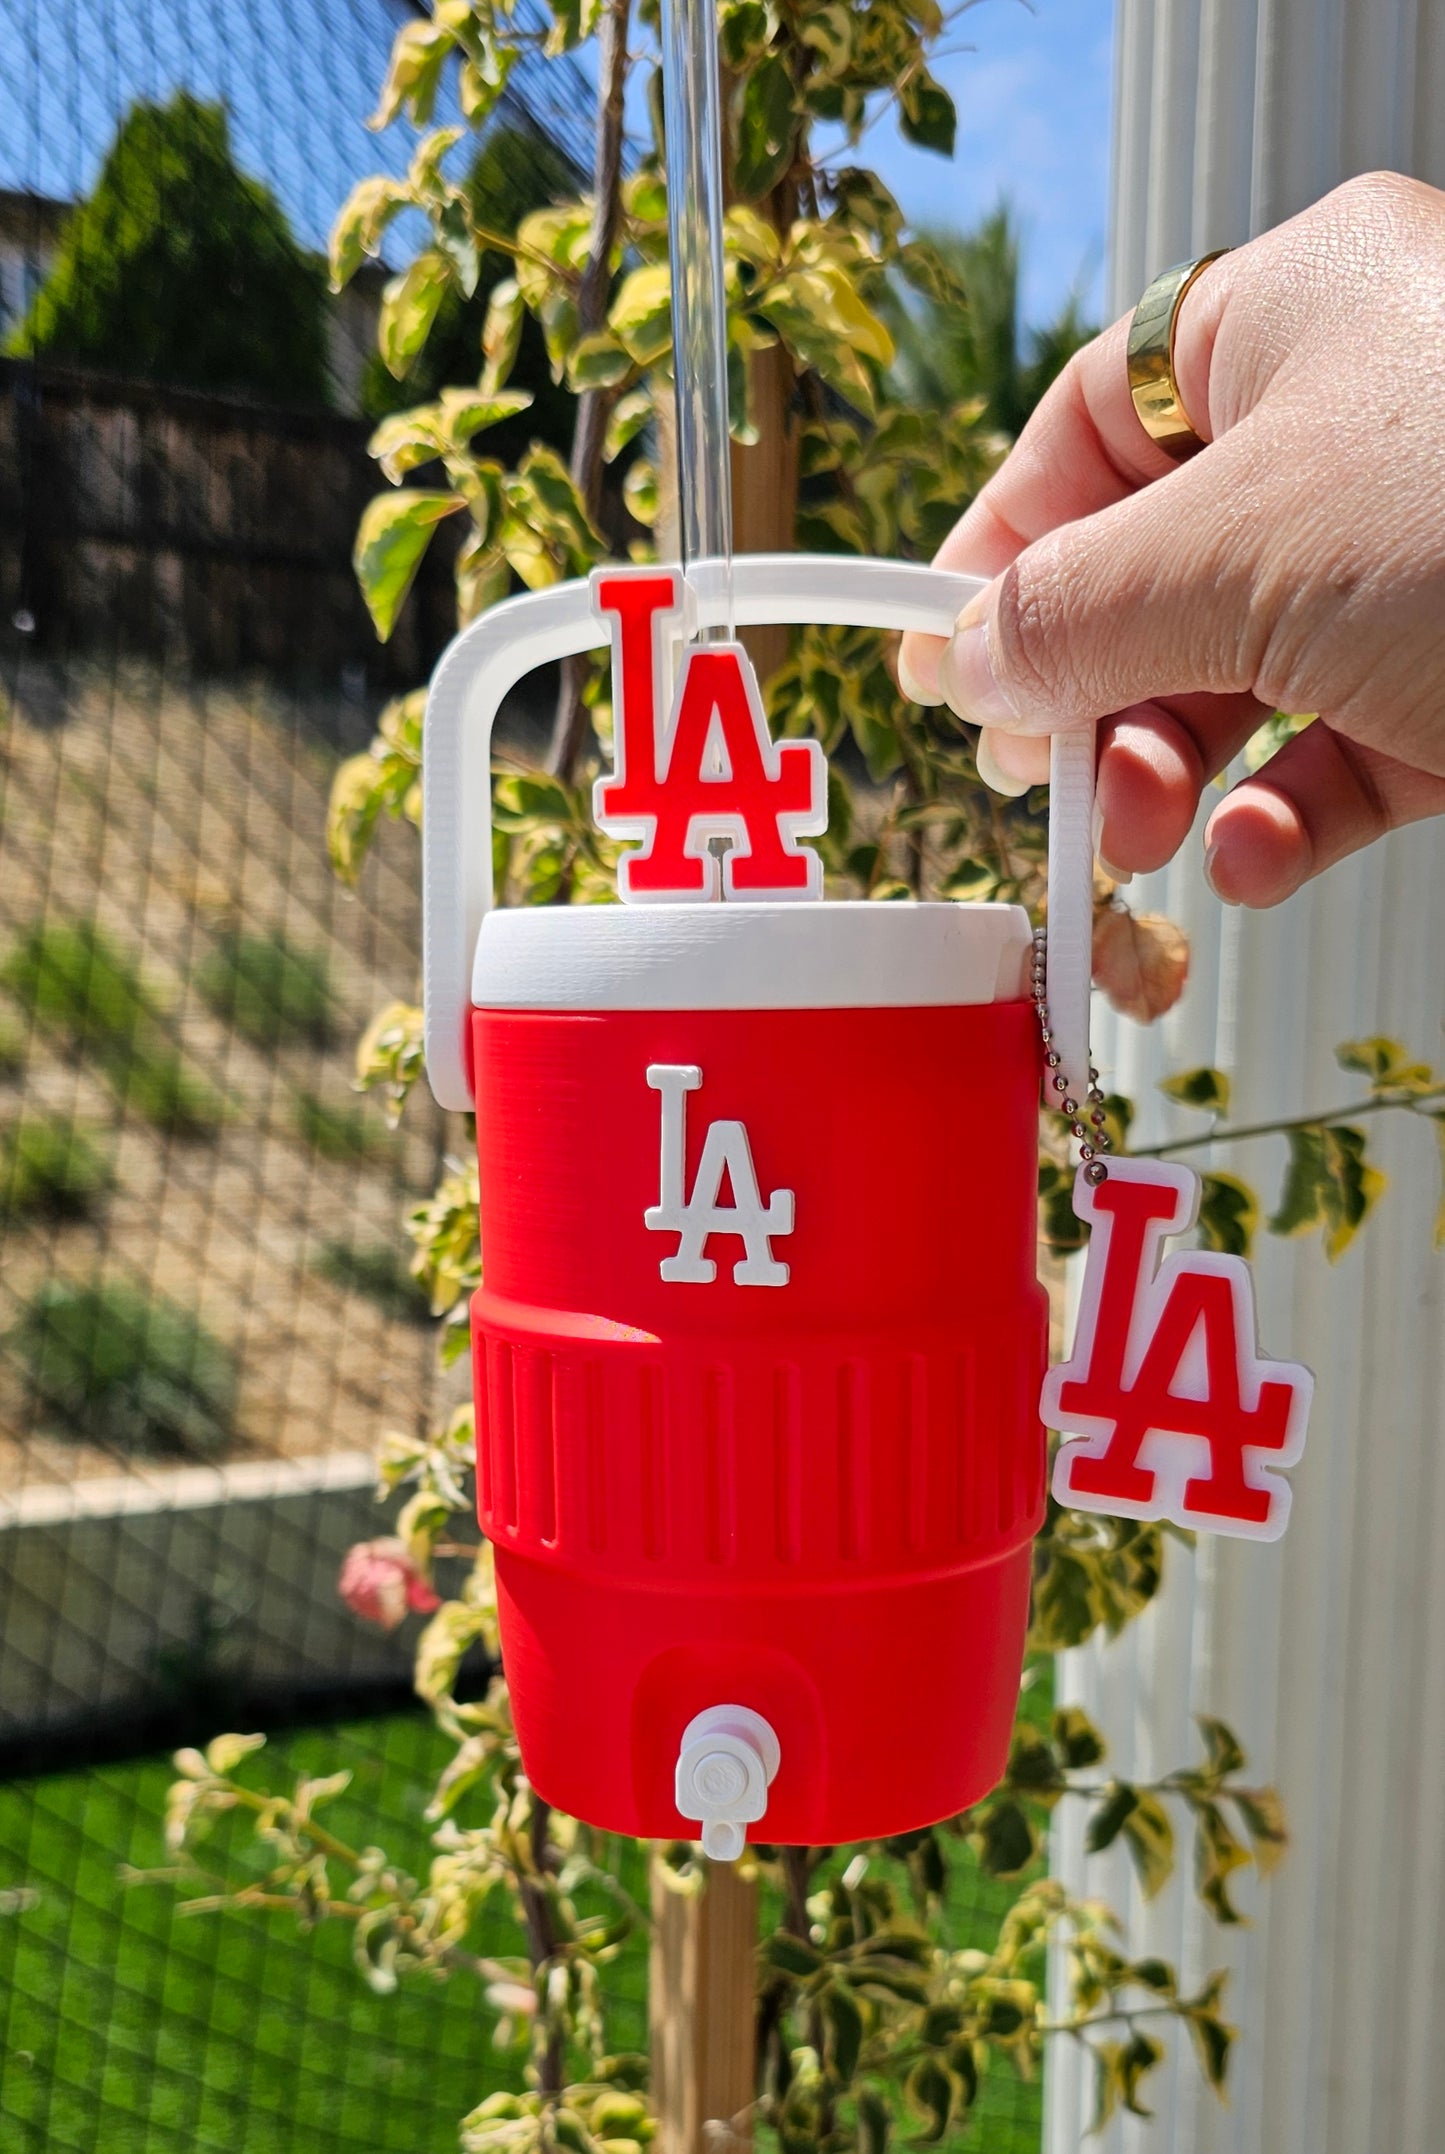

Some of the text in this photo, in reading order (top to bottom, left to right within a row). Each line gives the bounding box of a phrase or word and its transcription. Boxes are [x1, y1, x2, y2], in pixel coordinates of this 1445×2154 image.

[599, 577, 812, 891] LA
[644, 1063, 795, 1287] LA
[1058, 1178, 1294, 1523] LA
